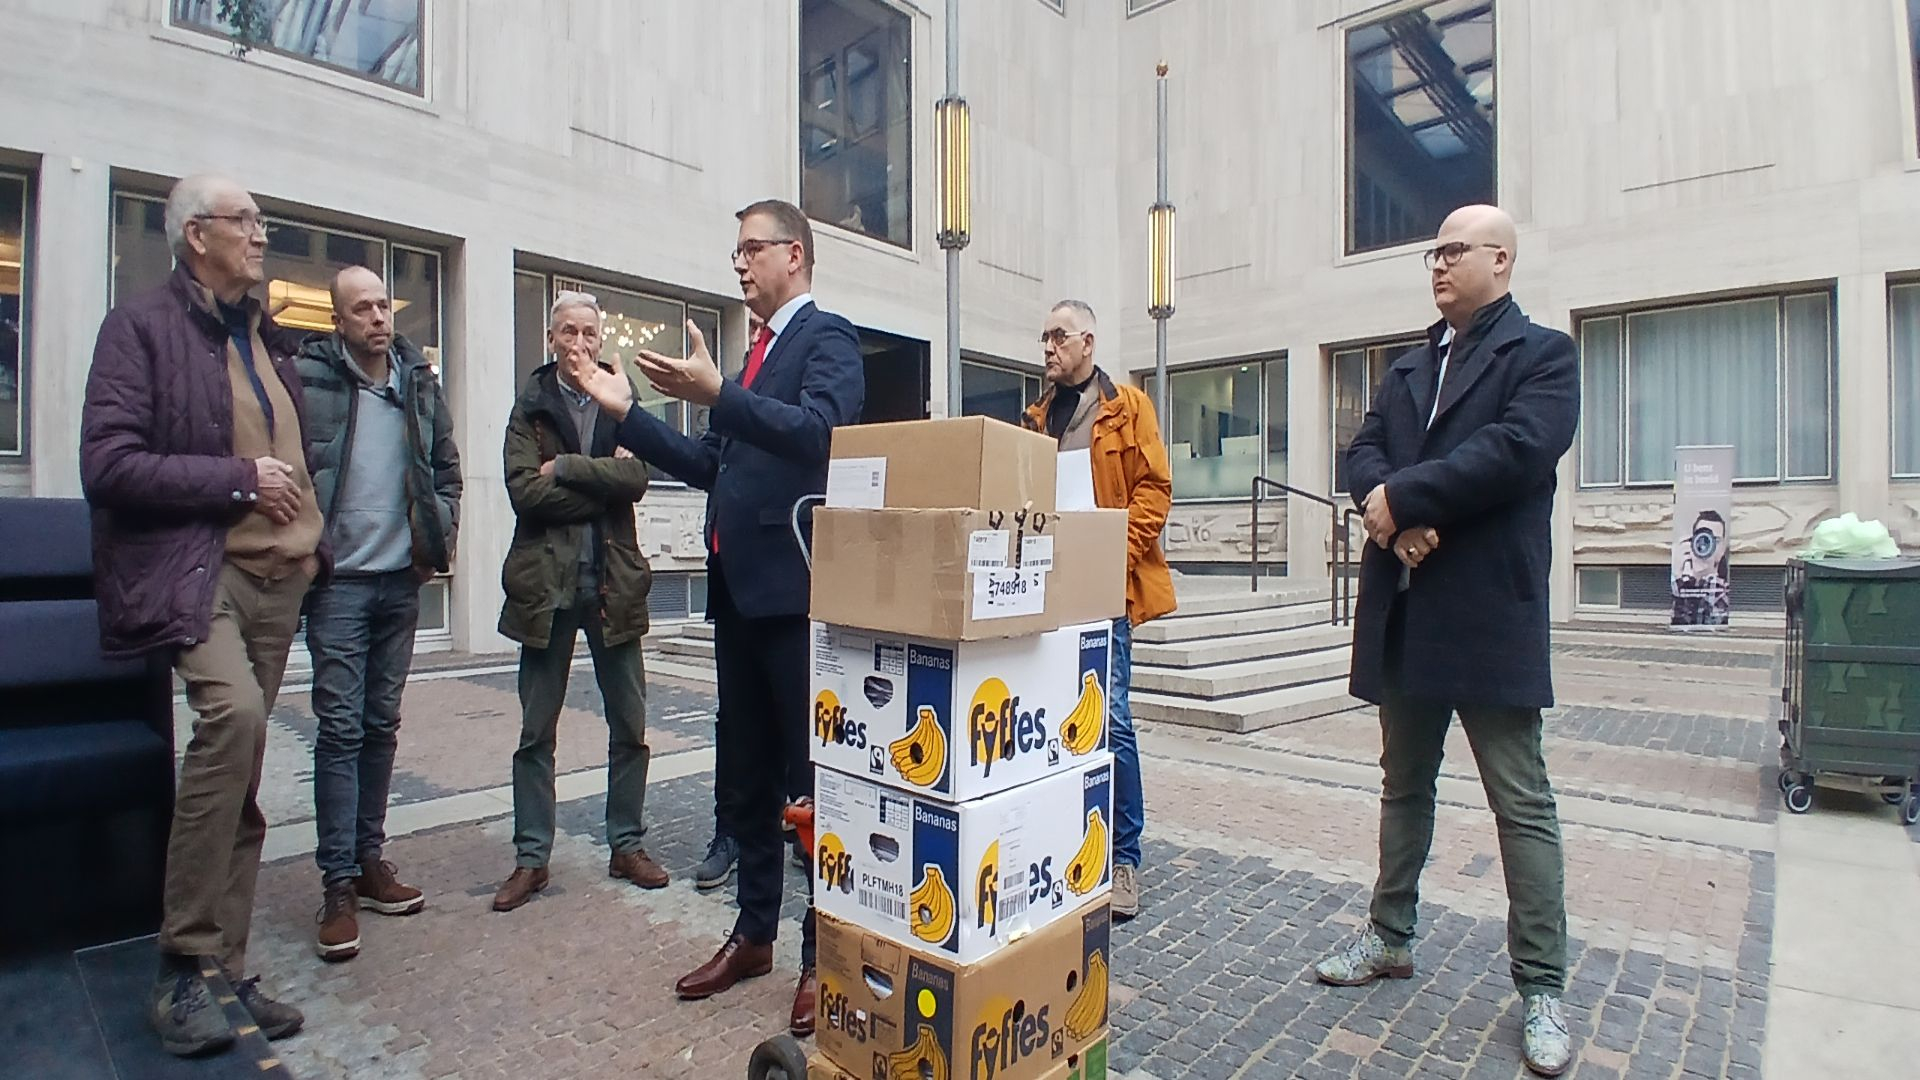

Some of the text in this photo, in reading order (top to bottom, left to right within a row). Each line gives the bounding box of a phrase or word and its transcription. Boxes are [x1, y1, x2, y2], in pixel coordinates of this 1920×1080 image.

[1080, 635, 1107, 650] Bananas
[909, 650, 951, 670] Bananas
[1084, 769, 1110, 790] Bananas
[914, 805, 957, 832] Bananas
[862, 873, 904, 898] PLFTMH18
